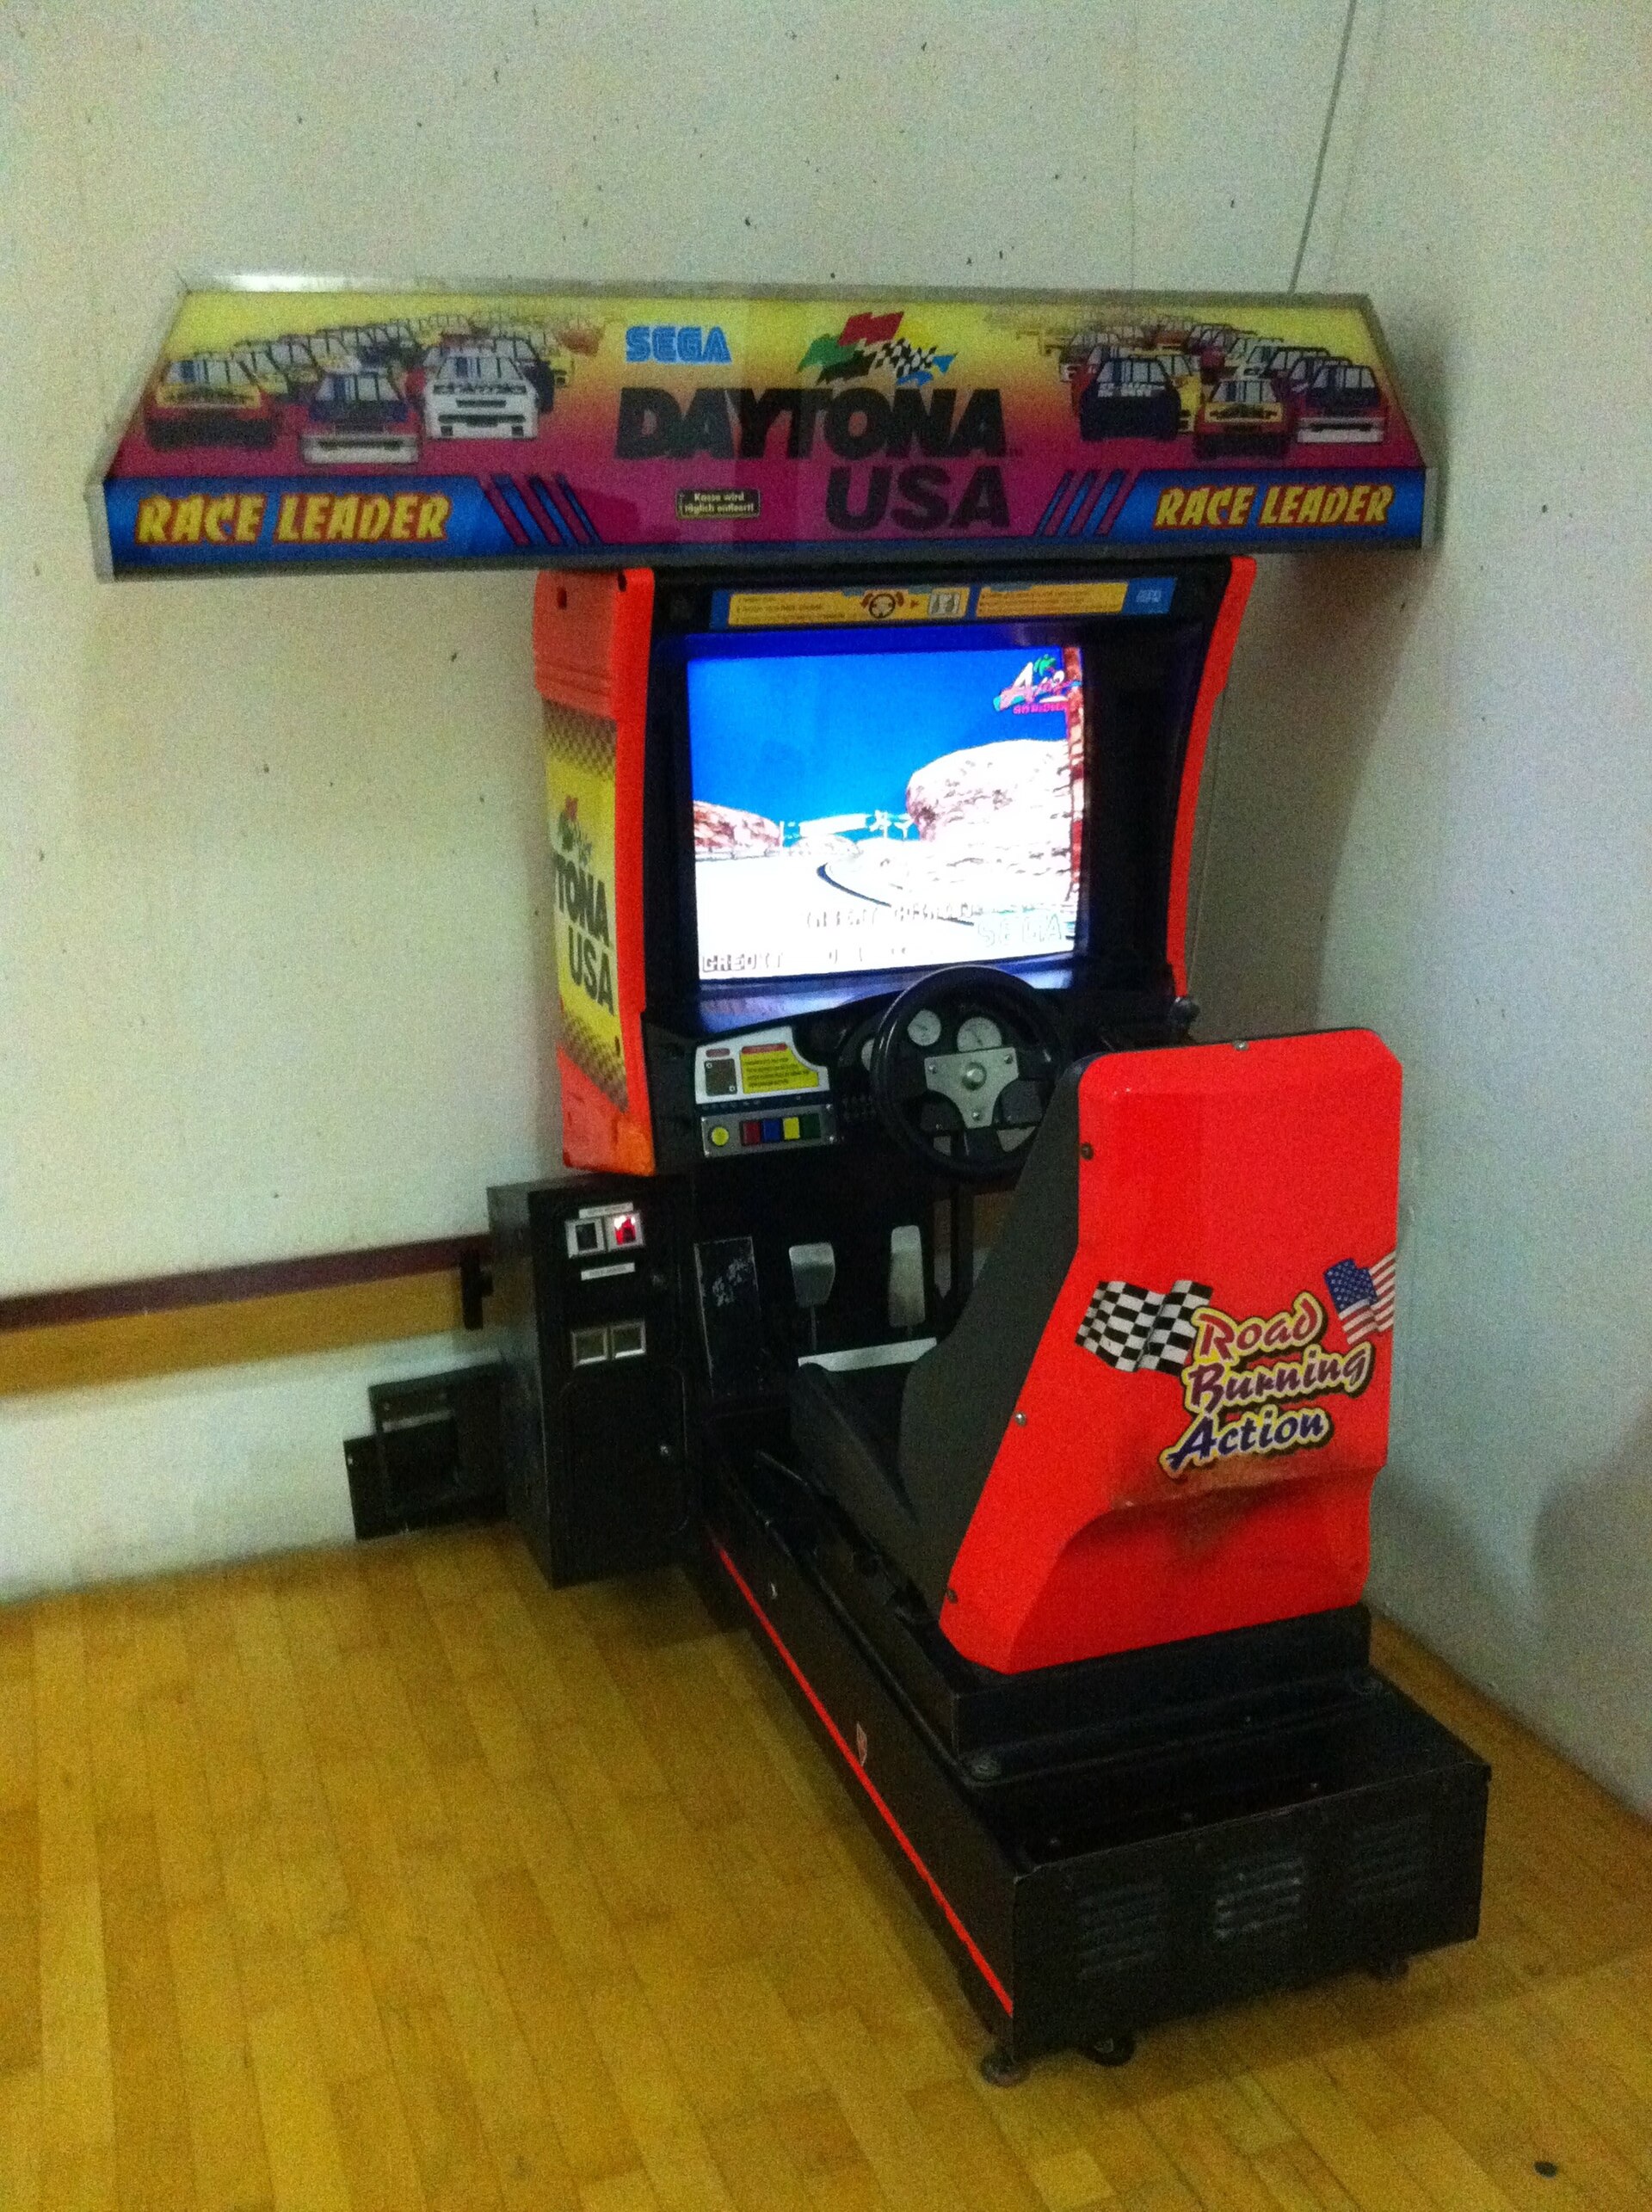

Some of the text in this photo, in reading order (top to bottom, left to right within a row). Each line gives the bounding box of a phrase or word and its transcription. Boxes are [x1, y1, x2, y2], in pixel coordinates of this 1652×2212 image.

[625, 325, 732, 364] SEGA
[613, 386, 1010, 461] DAYTONA
[134, 492, 452, 545] RACE LEADER
[824, 465, 1010, 534] USA
[1153, 482, 1397, 531] RACE LEADER
[567, 925, 614, 1016] USA
[1194, 1294, 1322, 1362] Road
[1184, 1345, 1370, 1414] Burning
[1162, 1408, 1328, 1475] Action
